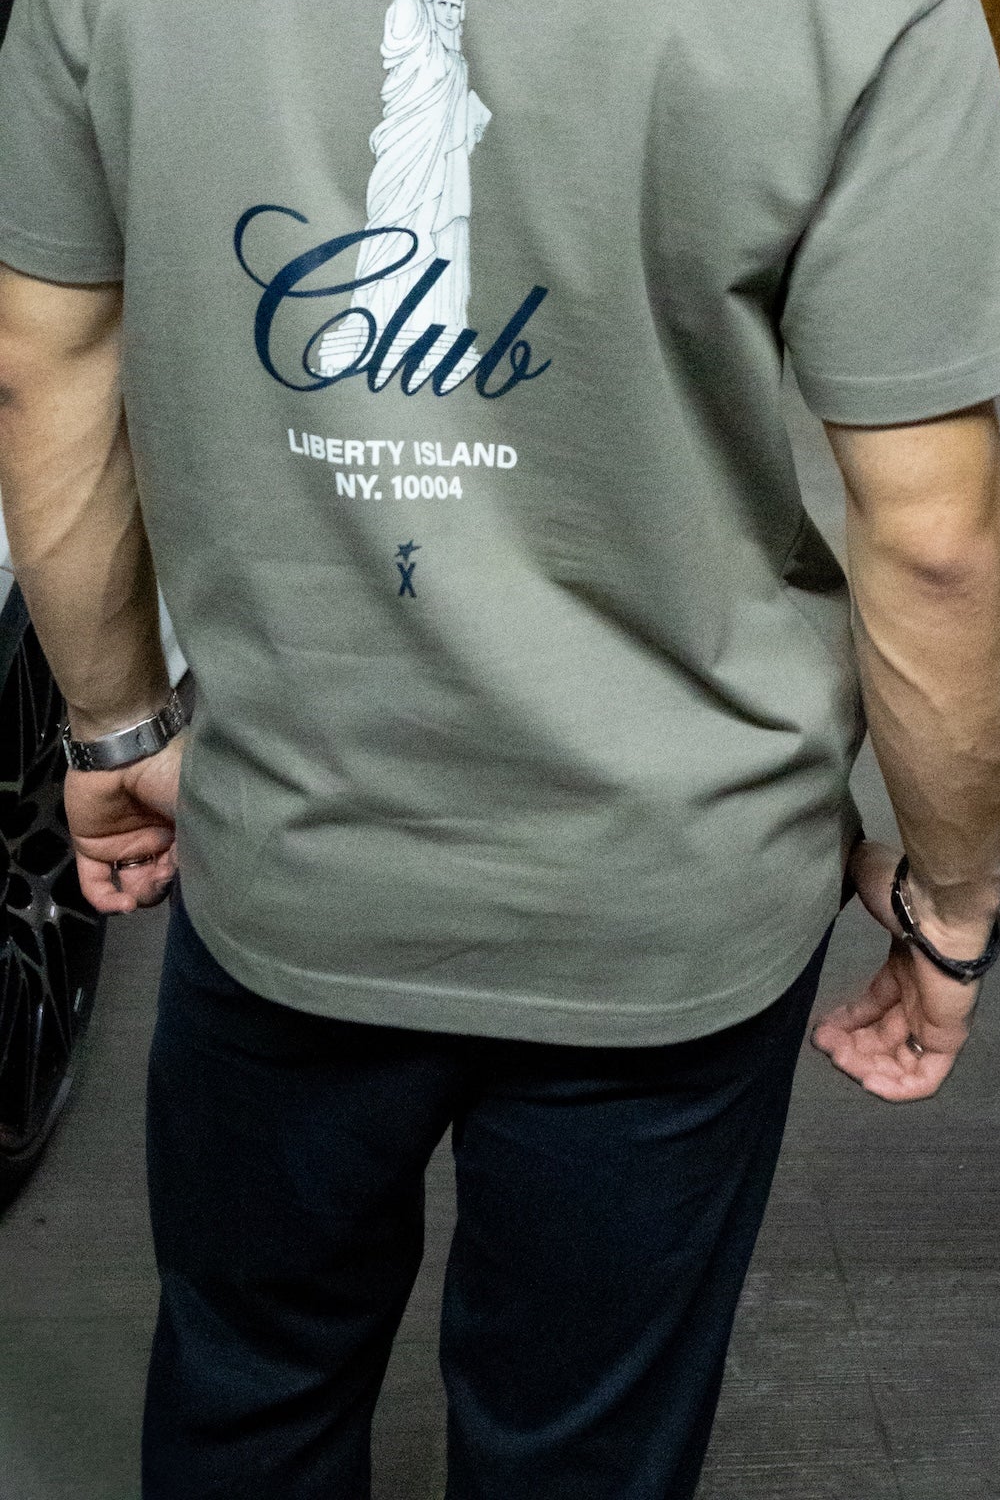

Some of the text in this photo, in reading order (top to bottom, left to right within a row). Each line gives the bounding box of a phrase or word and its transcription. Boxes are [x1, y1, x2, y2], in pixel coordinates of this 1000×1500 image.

[234, 204, 552, 399] Club
[288, 428, 518, 469] LIBERTY ISLAND
[335, 472, 463, 500] NY. 10004
